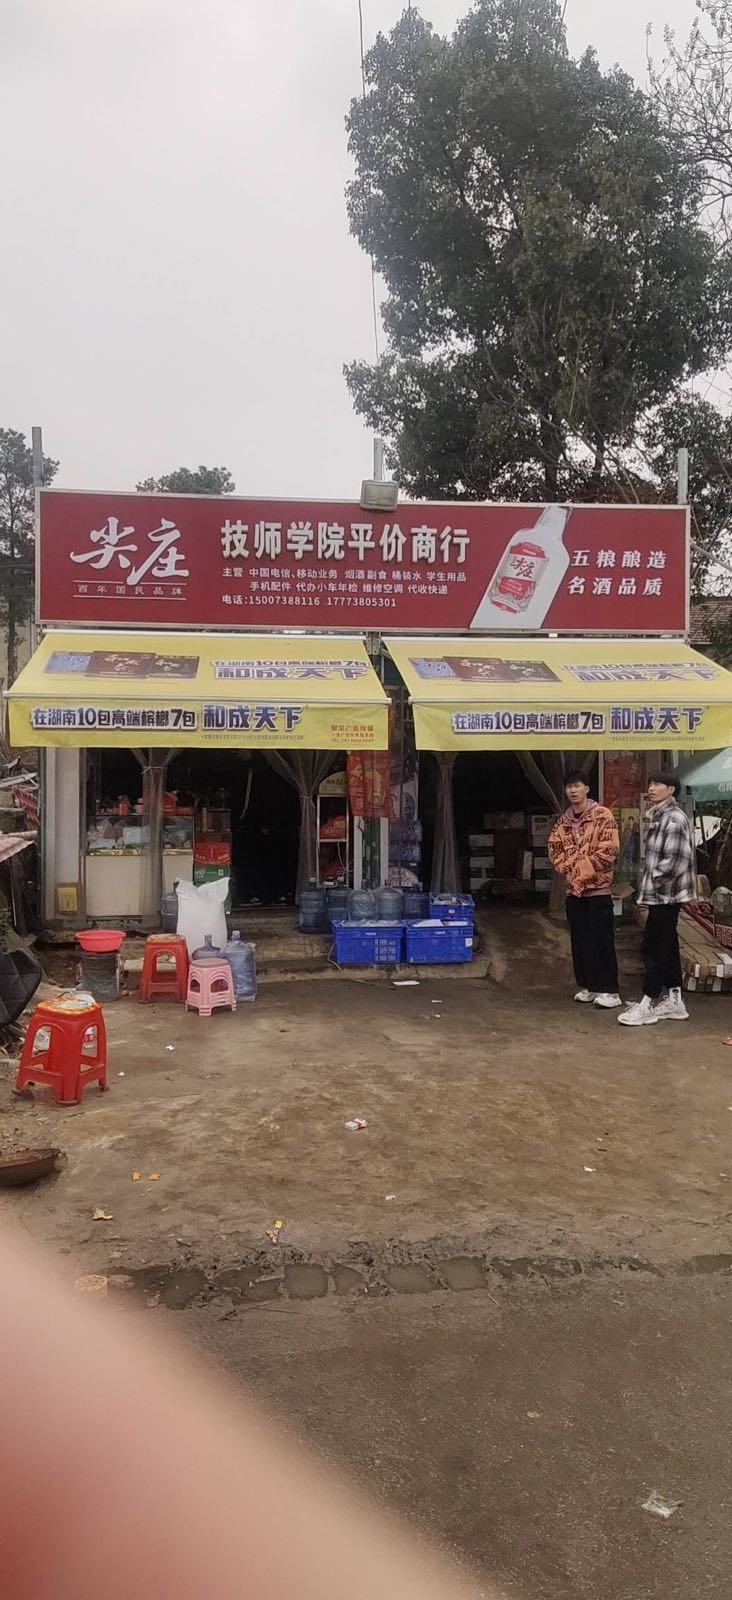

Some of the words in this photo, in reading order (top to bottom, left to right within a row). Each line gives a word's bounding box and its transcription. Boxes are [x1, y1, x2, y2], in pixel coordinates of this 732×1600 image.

[69, 516, 190, 586] 尖庄
[220, 519, 470, 564] 技师学院平价商行
[571, 549, 667, 569] 五粮酿造
[222, 567, 243, 578] 主营
[249, 568, 338, 579] 中国电信、移动业务
[392, 570, 422, 581] 桶装水
[426, 571, 467, 582] 学生用品
[78, 584, 183, 596] 百年国民品牌
[249, 581, 292, 592] 手机配件
[295, 582, 358, 593] 代办小车年检
[362, 583, 404, 594] 维修空调
[407, 584, 448, 595] 代收快递
[567, 576, 663, 596] 名酒品质
[326, 596, 397, 607] 17773805301
[217, 667, 368, 679] 和成天下
[202, 704, 302, 730] 和成天下
[610, 706, 704, 731] 和成天下
